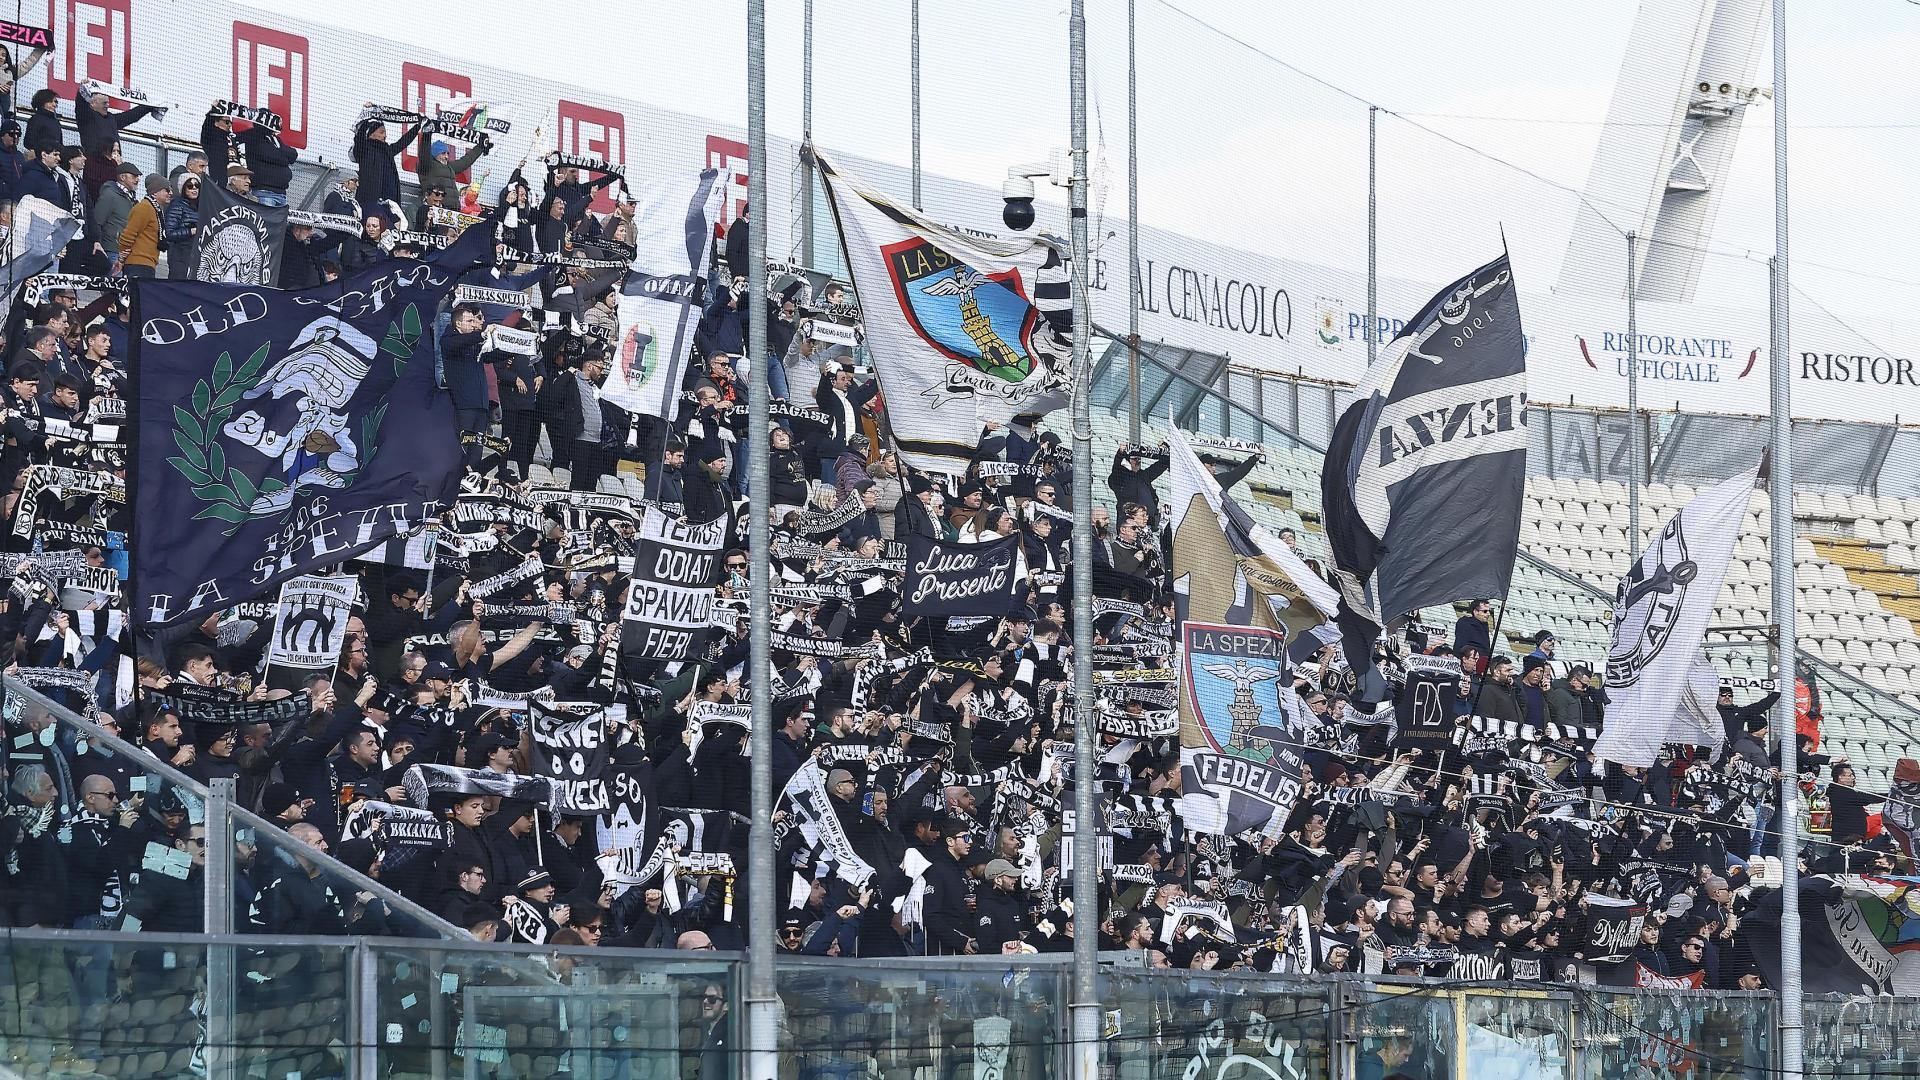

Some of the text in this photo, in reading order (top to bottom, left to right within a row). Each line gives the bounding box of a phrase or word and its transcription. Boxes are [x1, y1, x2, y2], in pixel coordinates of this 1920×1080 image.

[119, 87, 148, 102] SPEZIA
[438, 122, 481, 145] SPEZIA
[905, 249, 933, 279] LA
[141, 292, 268, 345] OLD
[1167, 265, 1292, 343] CENACOLO
[1602, 331, 1733, 359] RISTORANTE
[1617, 358, 1720, 383] UFFICIALE
[1229, 440, 1242, 449] LA
[456, 502, 494, 522] ULTRAS
[70, 532, 107, 547] SANA
[654, 548, 715, 585] ODIATI
[915, 546, 978, 575] Luca
[911, 559, 1011, 604] Presente
[146, 577, 230, 622] LA
[630, 584, 713, 623] SPAVALDI
[641, 627, 693, 660] FIERI
[1192, 632, 1216, 652] LA
[1413, 681, 1452, 726] FDS
[390, 822, 443, 841] BRIANZA
